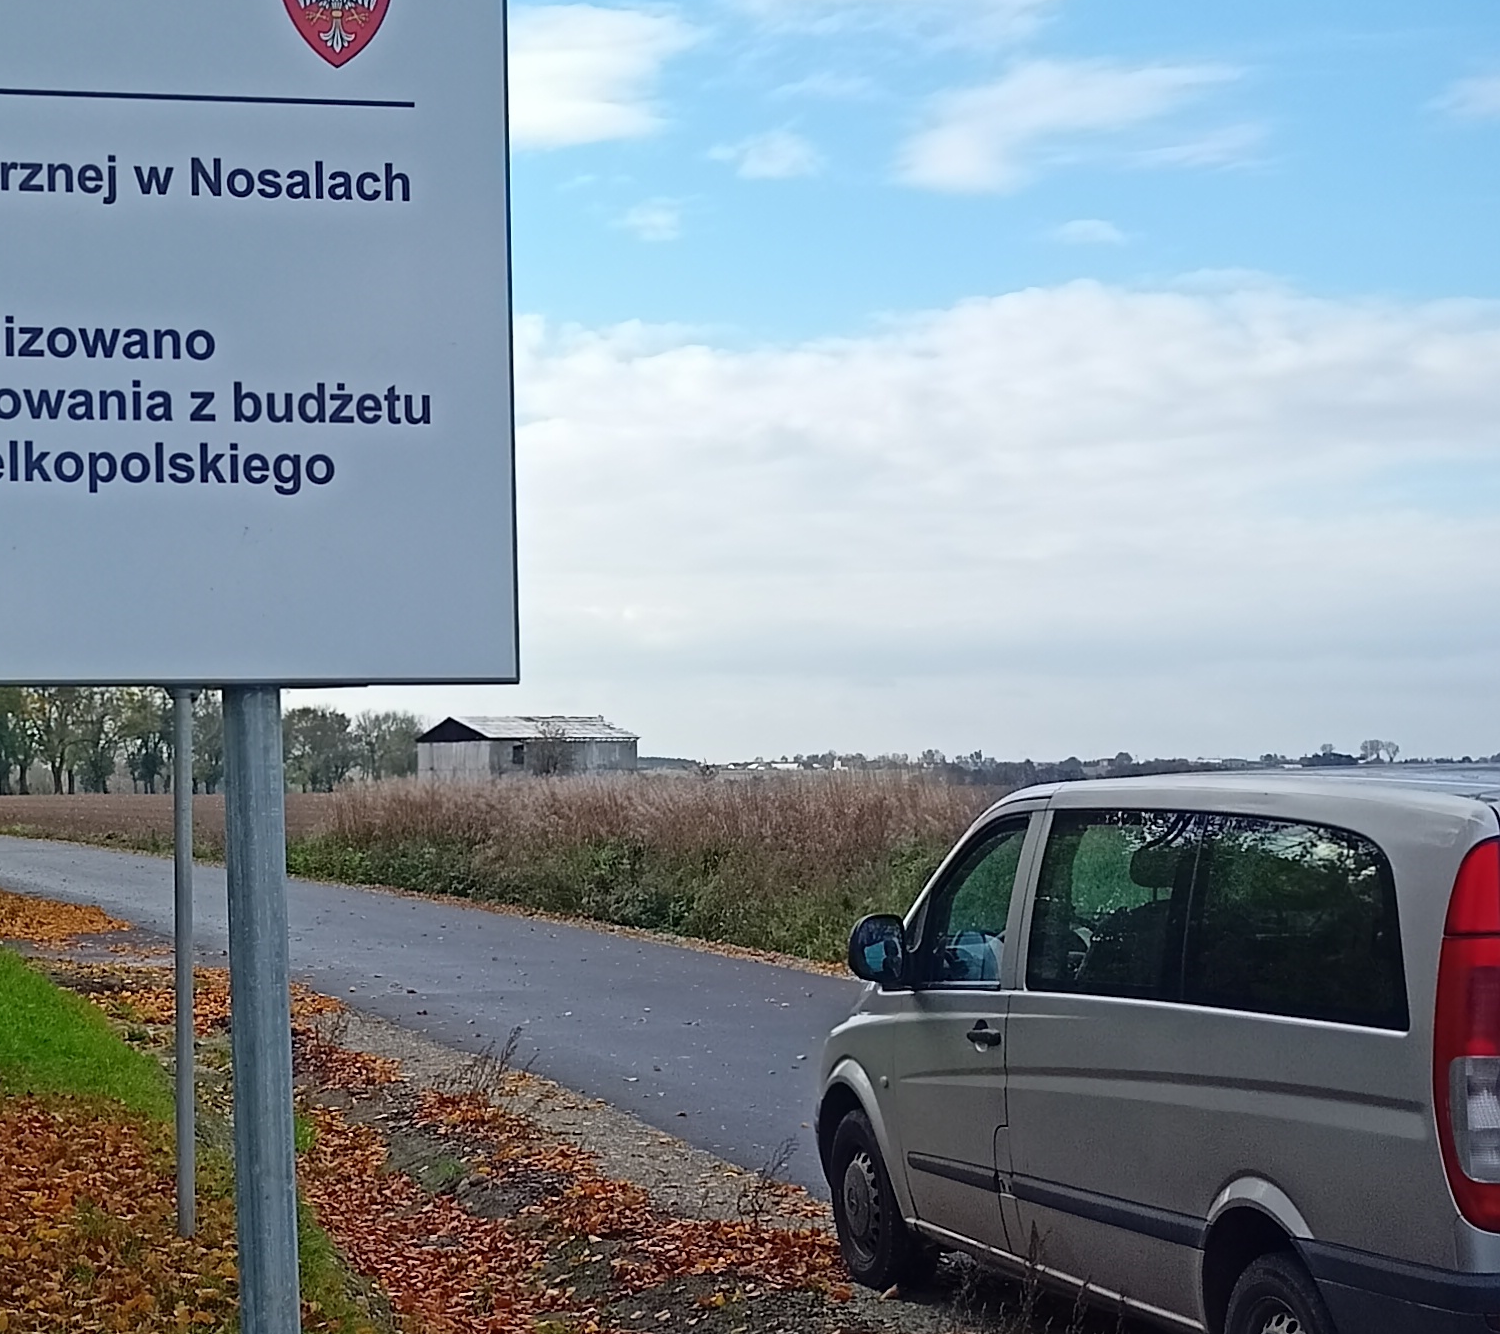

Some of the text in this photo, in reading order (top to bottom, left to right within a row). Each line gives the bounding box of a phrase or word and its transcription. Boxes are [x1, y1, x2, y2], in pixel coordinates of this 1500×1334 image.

[134, 166, 174, 195] w
[191, 157, 410, 201] Nosalach
[190, 391, 216, 422] z
[234, 381, 430, 424] budżetu
